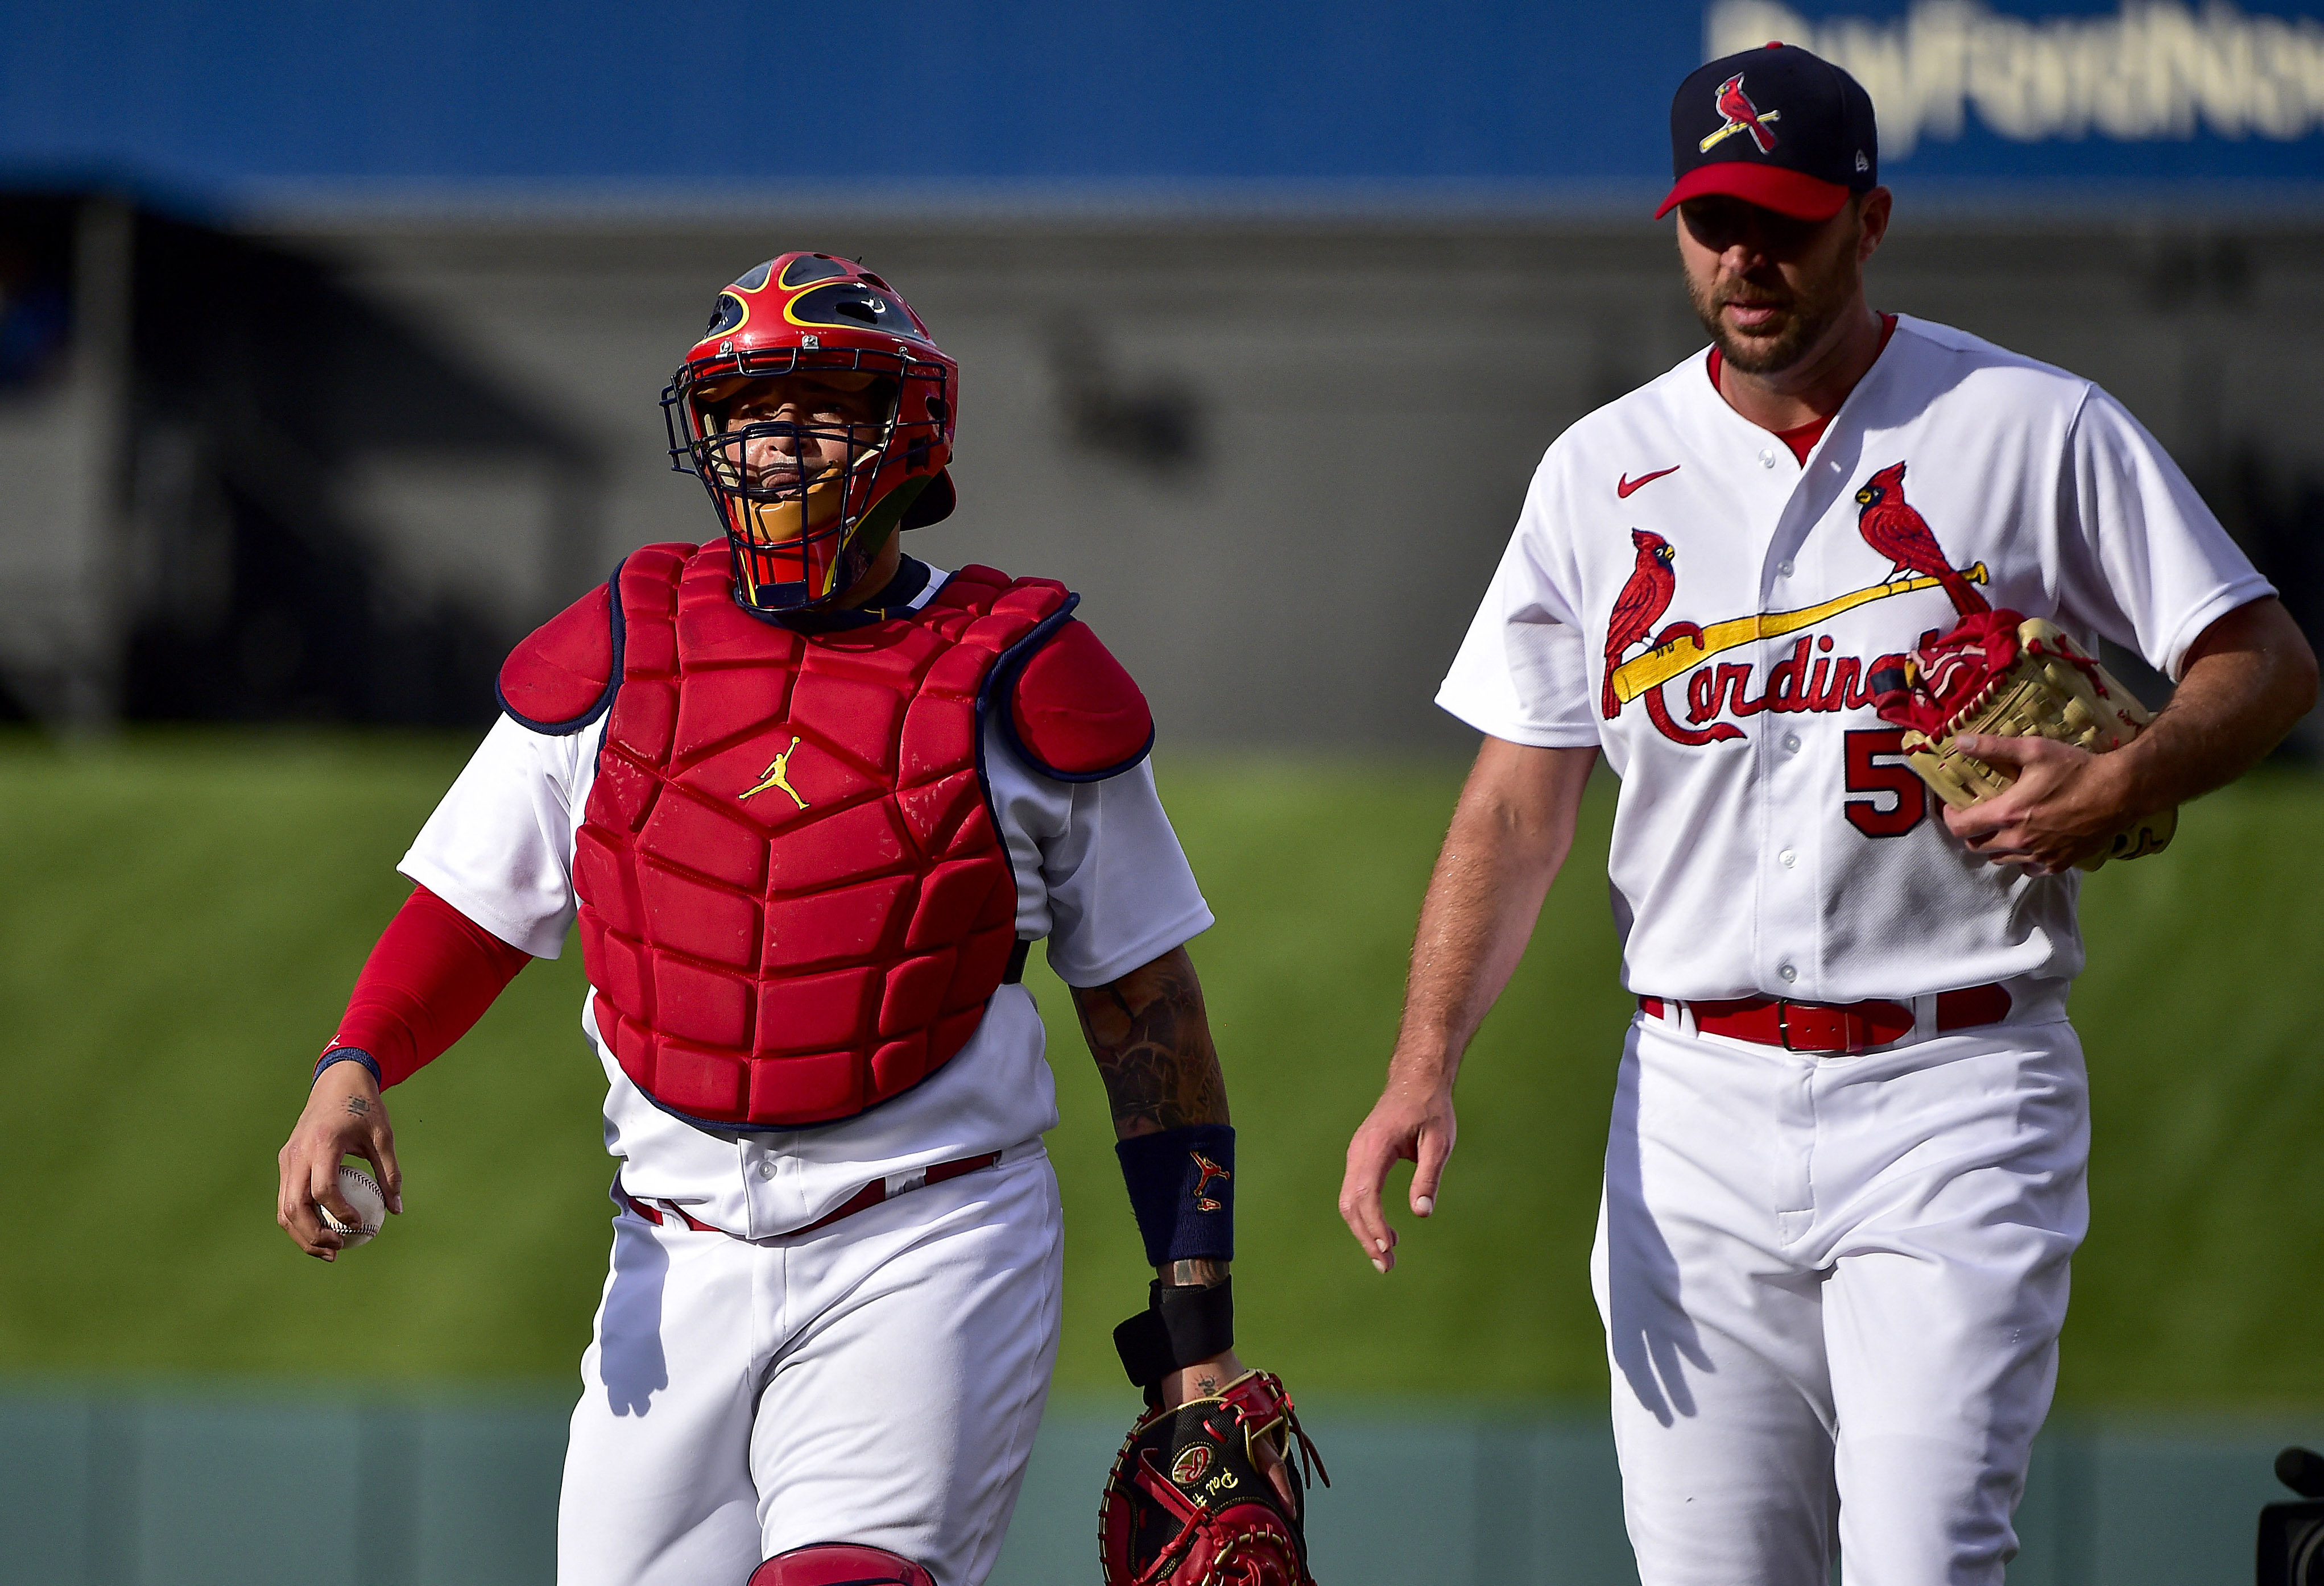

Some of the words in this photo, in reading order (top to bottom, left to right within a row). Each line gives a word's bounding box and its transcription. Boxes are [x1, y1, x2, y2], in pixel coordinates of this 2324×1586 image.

[1643, 620, 1938, 746] Cardin
[1844, 728, 1948, 839] 5
[1197, 1198, 1221, 1211] 4
